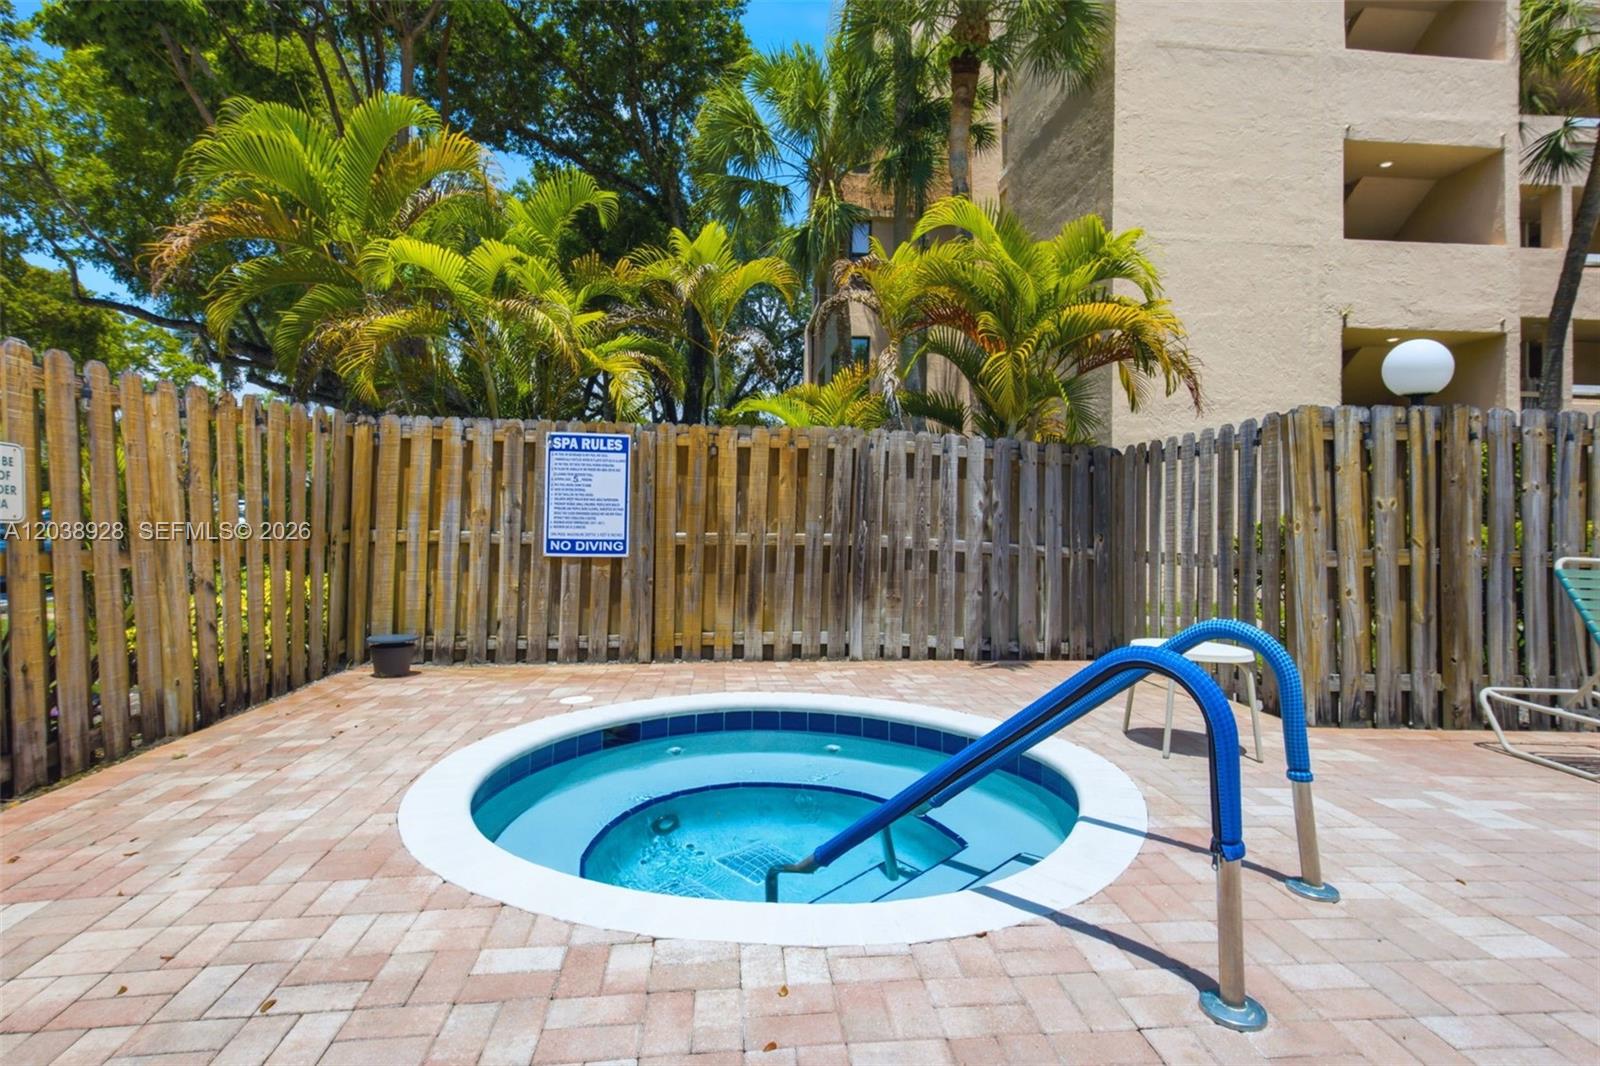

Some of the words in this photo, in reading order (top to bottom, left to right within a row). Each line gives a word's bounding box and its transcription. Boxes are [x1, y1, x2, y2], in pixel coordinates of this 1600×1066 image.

[553, 437, 579, 450] SPA
[582, 438, 623, 451] RULES
[2, 456, 14, 467] BE
[0, 470, 11, 480] OF
[550, 541, 571, 551] NO
[575, 541, 624, 552] DIVING
